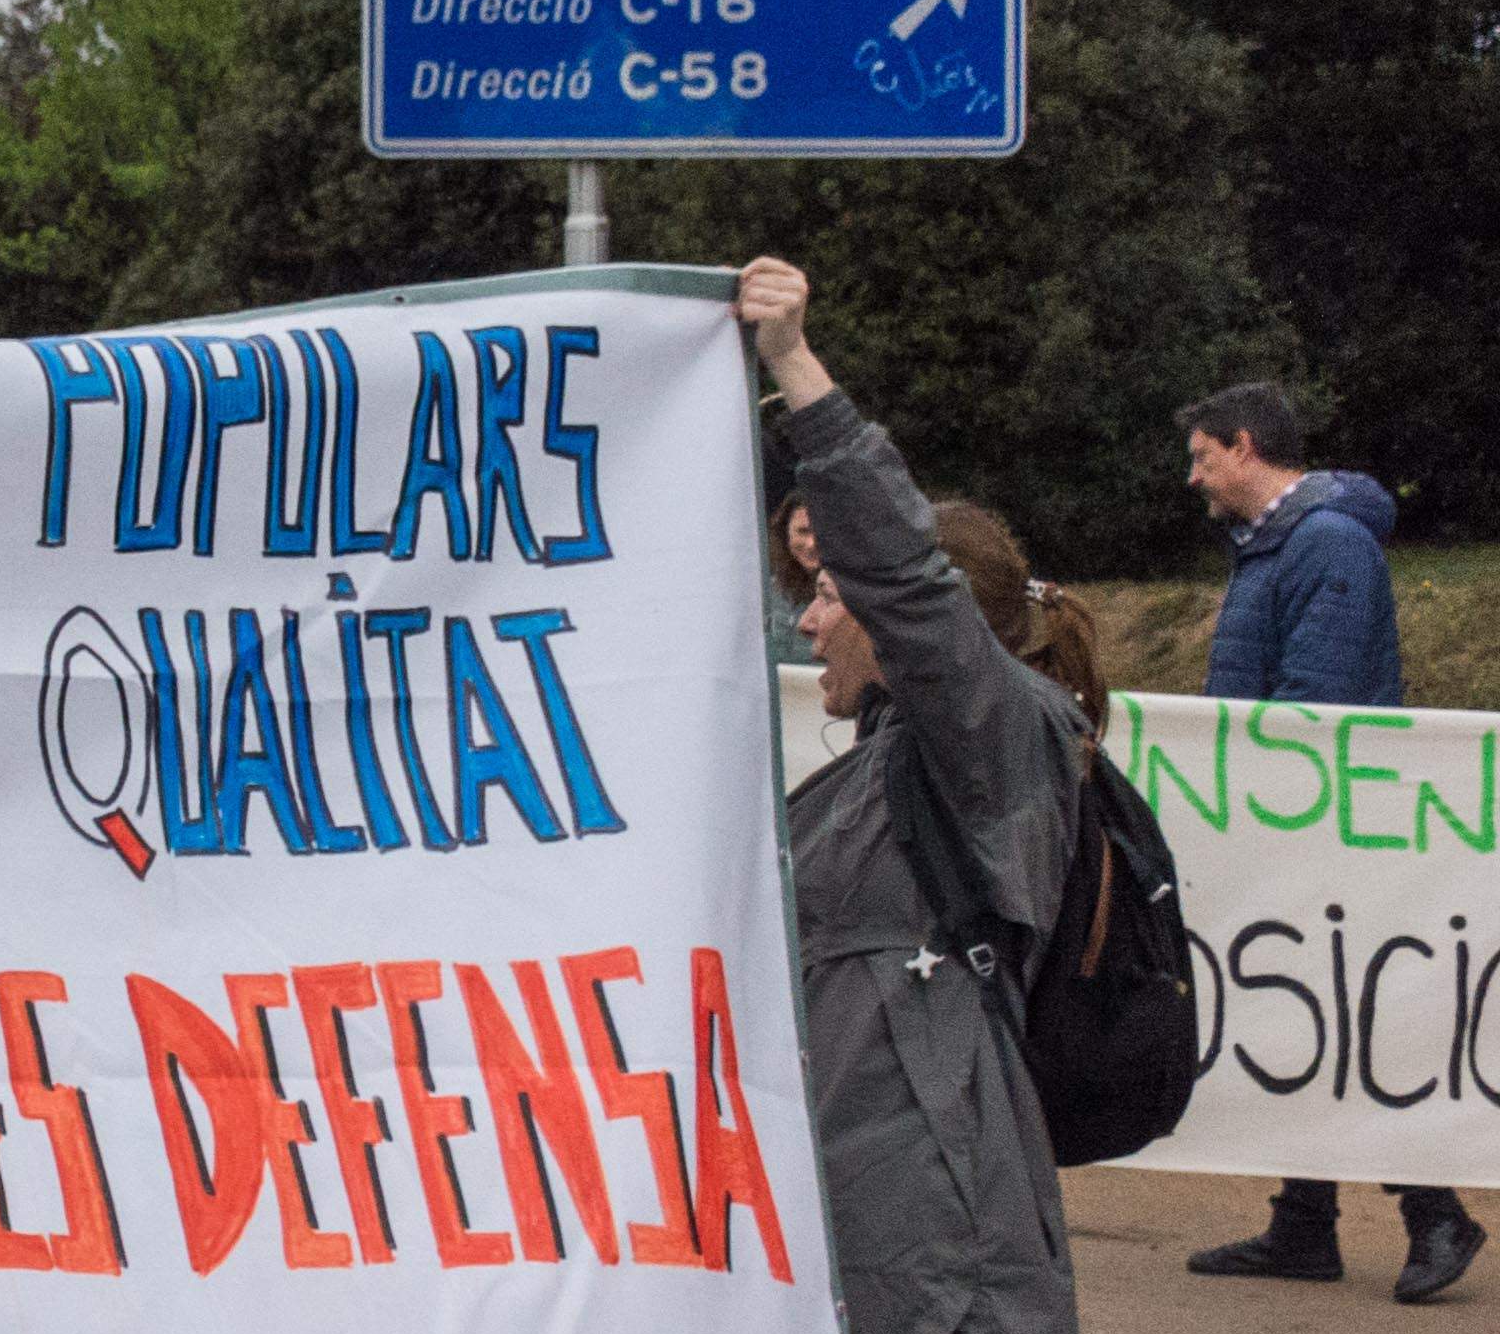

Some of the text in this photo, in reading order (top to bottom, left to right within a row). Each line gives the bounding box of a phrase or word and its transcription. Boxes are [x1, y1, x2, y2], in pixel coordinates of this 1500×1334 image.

[411, 50, 770, 101] Direcció C-58
[22, 324, 614, 569] POPULARS
[121, 943, 797, 1289] DEFENSA
